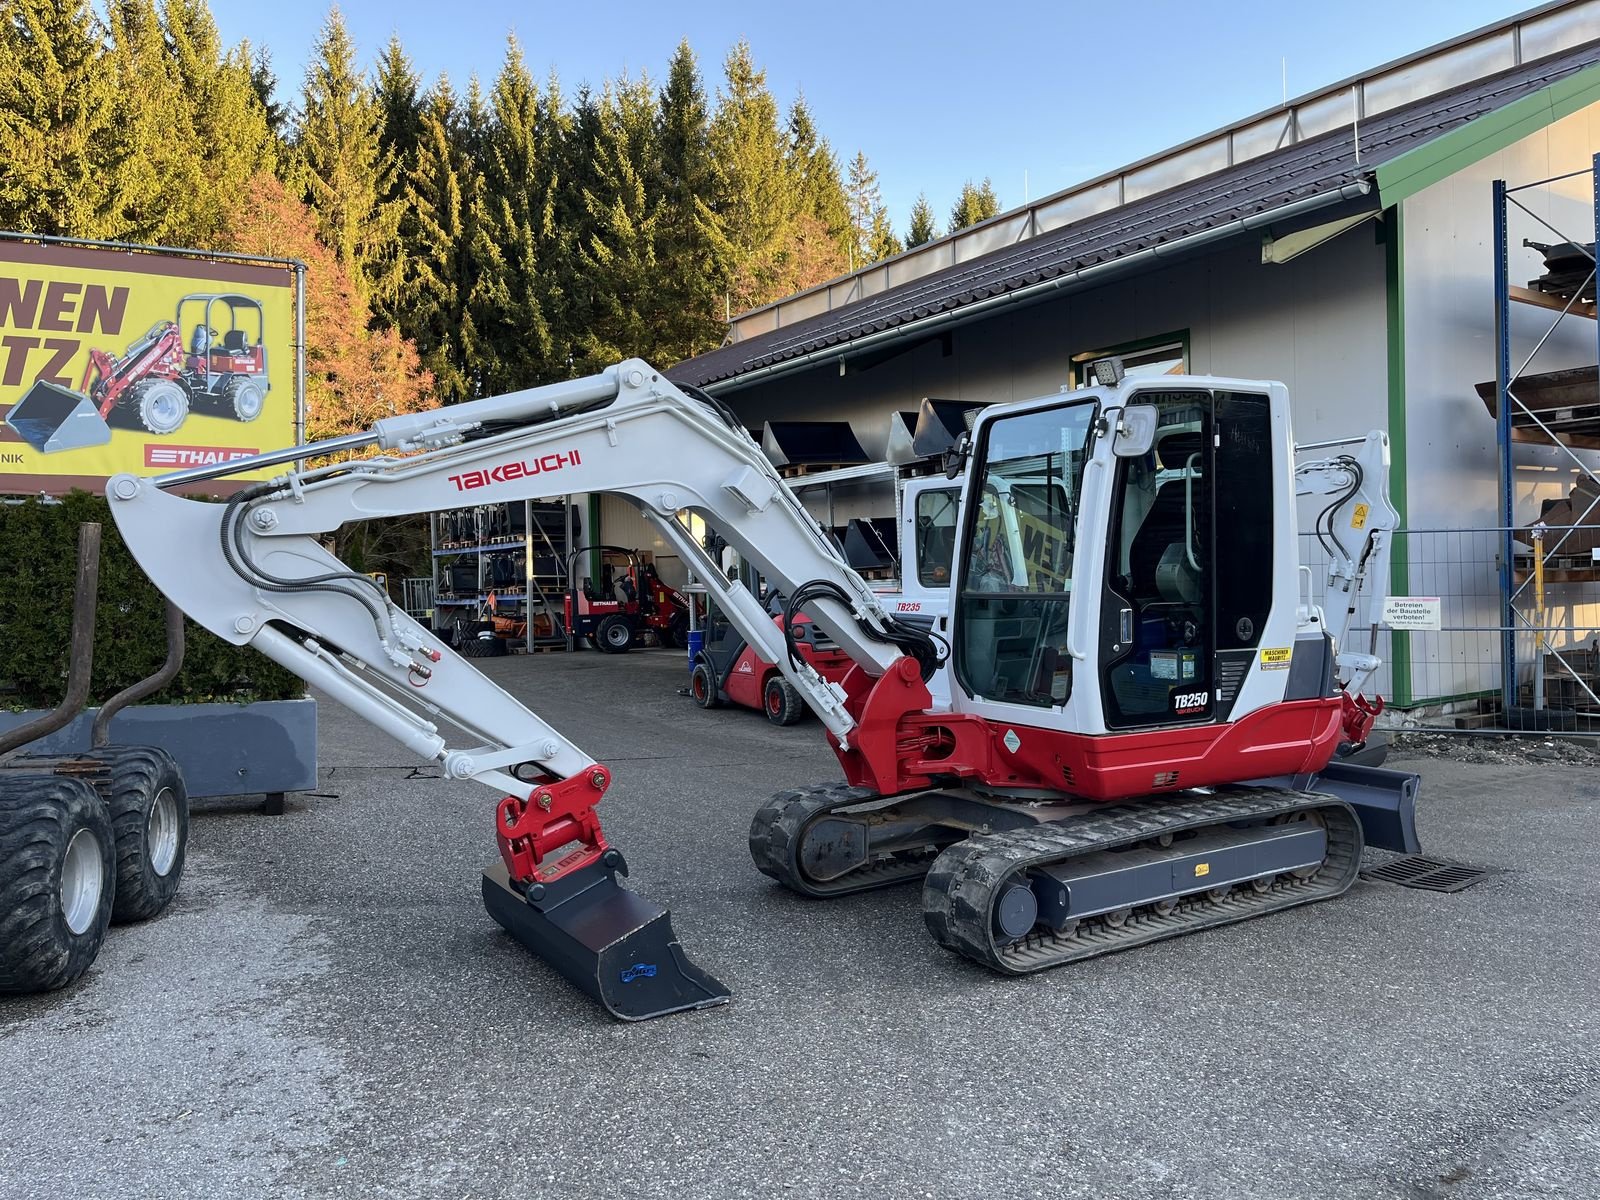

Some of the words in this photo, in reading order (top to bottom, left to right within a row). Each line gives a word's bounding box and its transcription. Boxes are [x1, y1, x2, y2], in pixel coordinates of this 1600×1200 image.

[0, 277, 130, 335] NEN
[2, 336, 80, 388] TZ
[1, 454, 24, 463] NIK
[448, 450, 581, 491] TAKEUCHI
[897, 602, 921, 611] TB235
[1174, 691, 1209, 709] TB250
